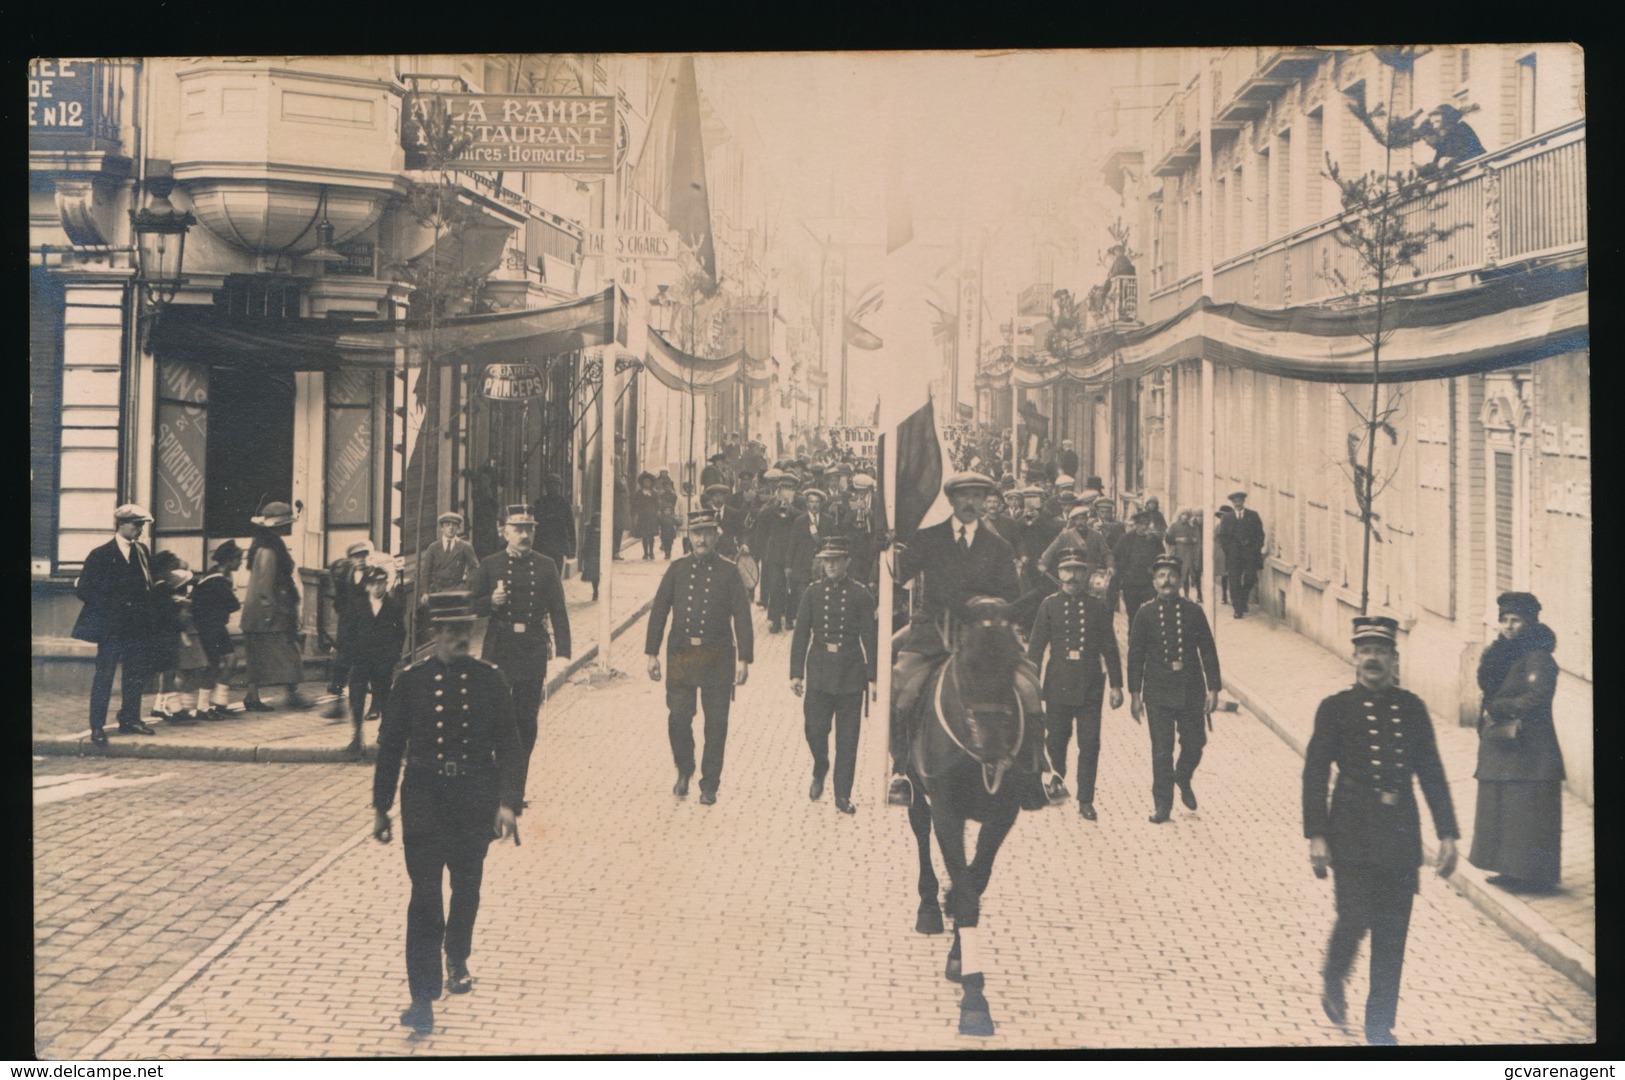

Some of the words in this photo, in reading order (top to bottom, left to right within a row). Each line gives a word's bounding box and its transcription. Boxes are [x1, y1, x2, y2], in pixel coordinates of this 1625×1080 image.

[445, 98, 488, 122] LA
[502, 99, 608, 125] RAMPE
[627, 236, 669, 256] CIGARES
[489, 364, 536, 378] CIGARES
[483, 377, 542, 398] PRINCEPS
